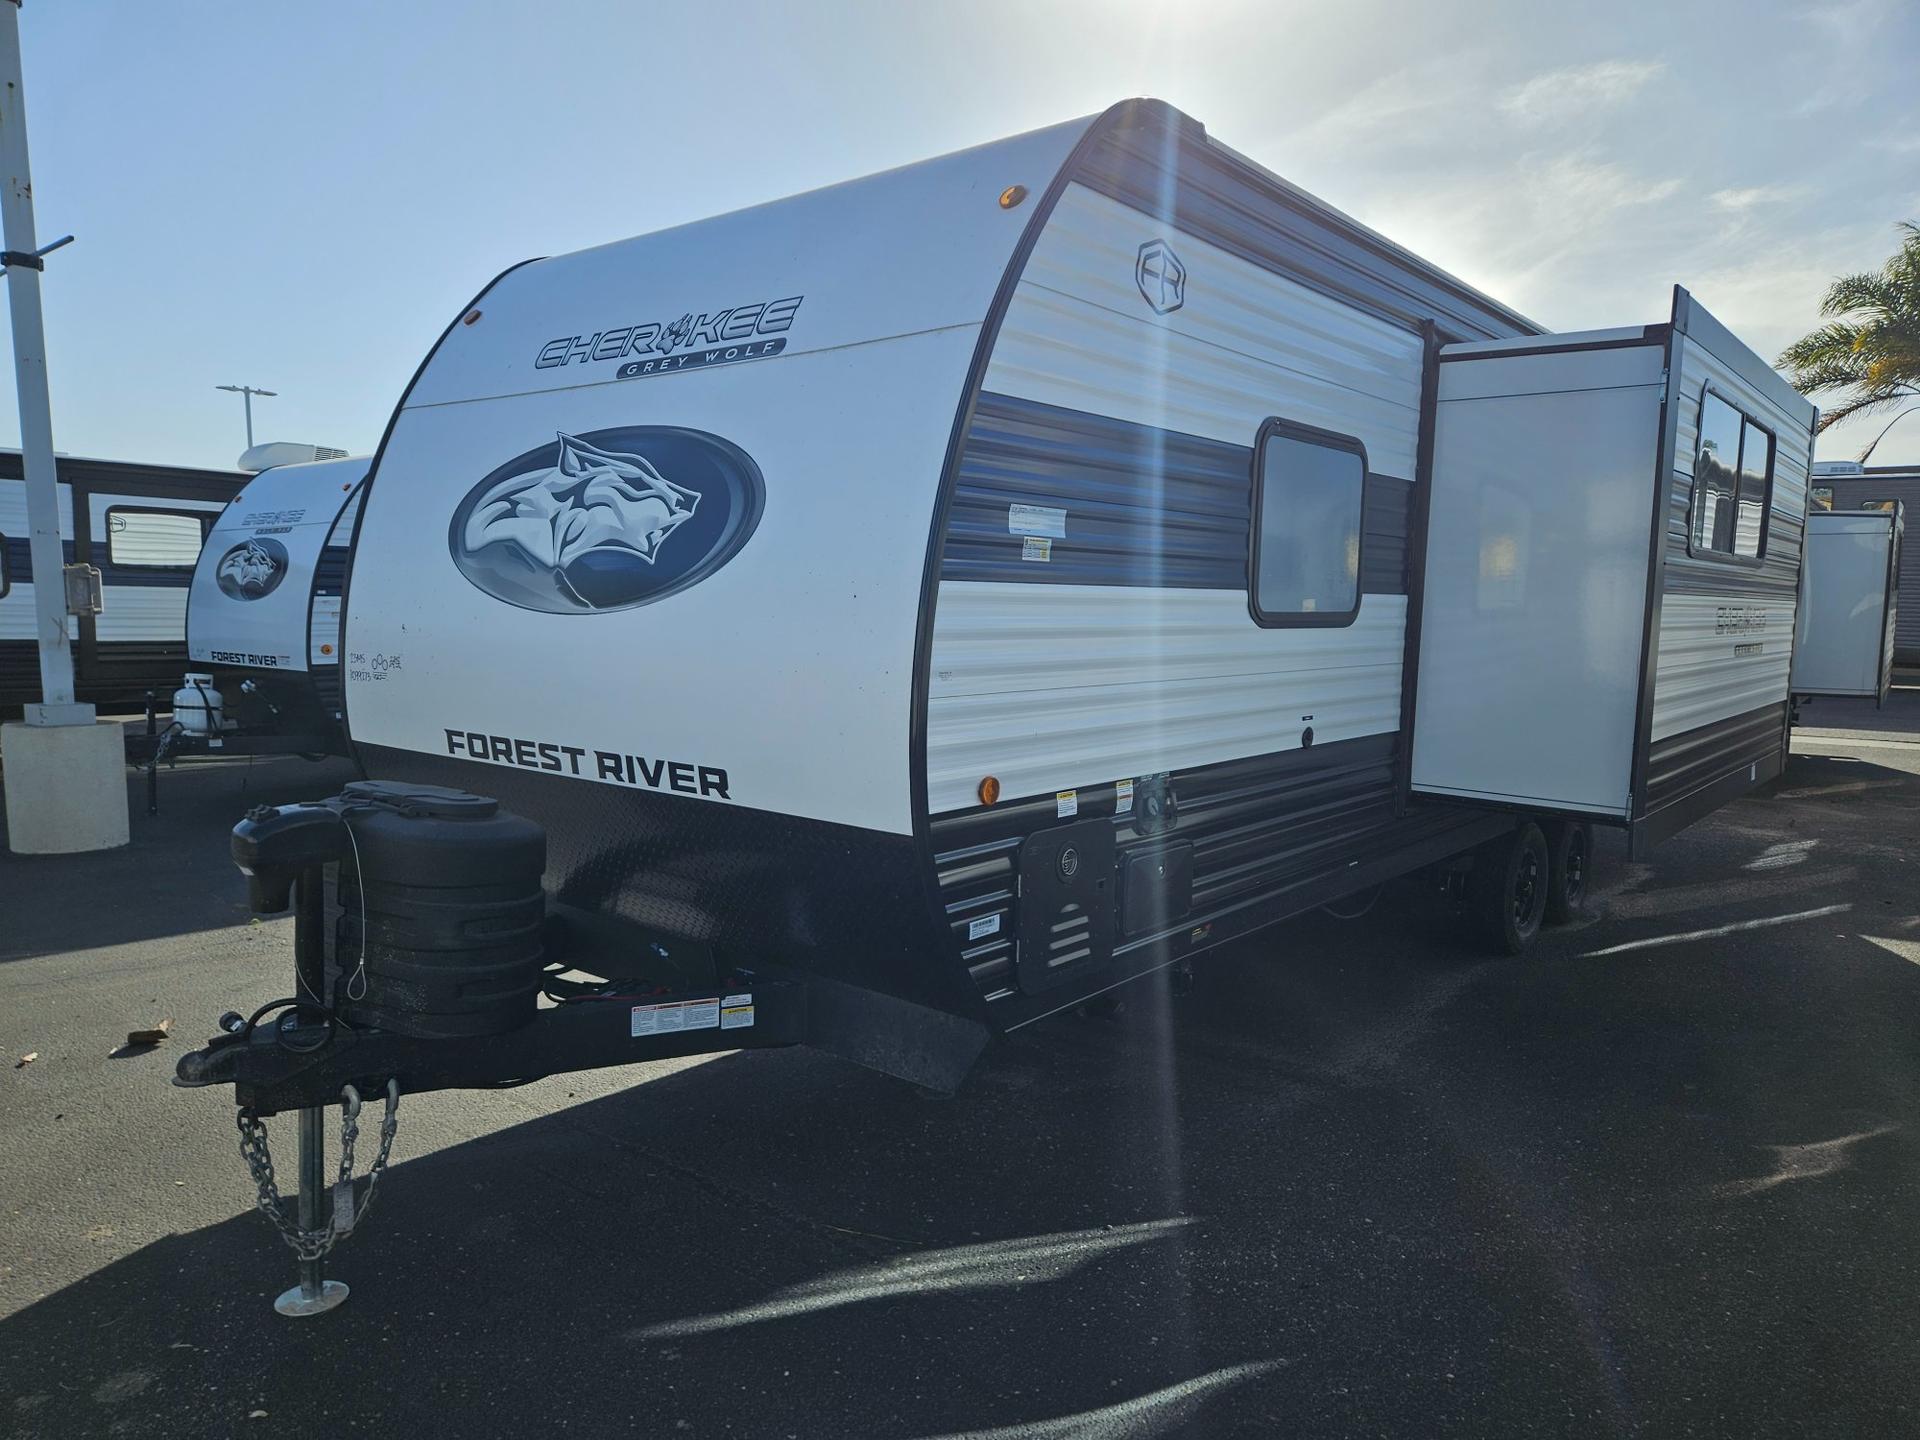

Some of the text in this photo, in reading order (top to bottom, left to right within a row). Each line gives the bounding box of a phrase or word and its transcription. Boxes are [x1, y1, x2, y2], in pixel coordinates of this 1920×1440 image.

[626, 342, 776, 375] GREY WOLF
[211, 651, 246, 664] FOREST
[248, 653, 277, 666] RIVER
[444, 728, 732, 800] FOREST RIVER
